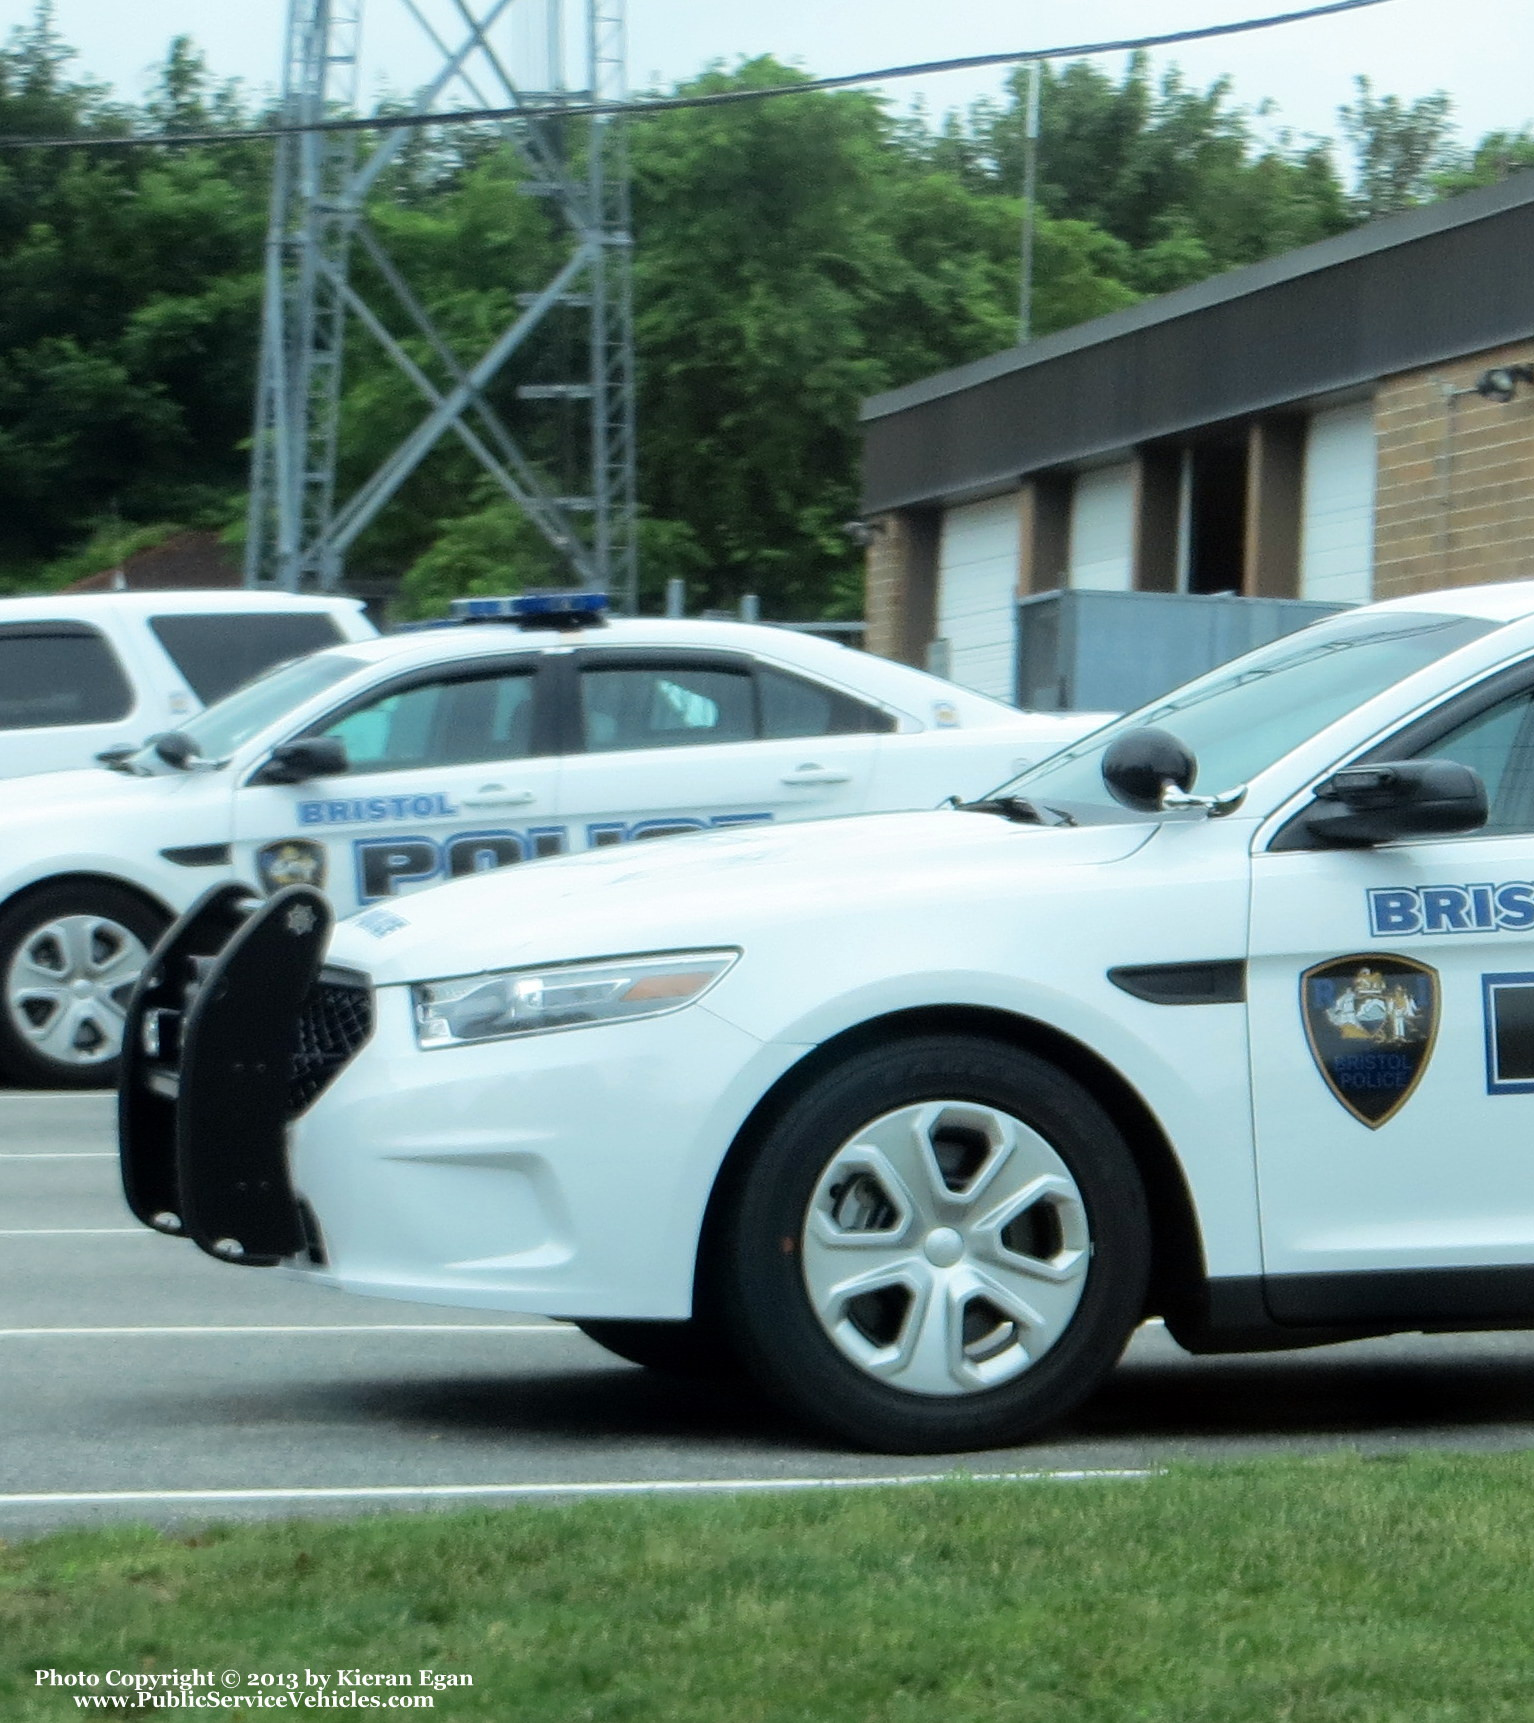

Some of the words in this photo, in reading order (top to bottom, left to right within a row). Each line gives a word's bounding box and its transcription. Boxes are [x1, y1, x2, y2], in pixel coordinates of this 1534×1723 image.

[299, 792, 459, 827] BRISTOL
[1333, 1054, 1412, 1071] BRISTOL
[1340, 1071, 1406, 1088] POLICE
